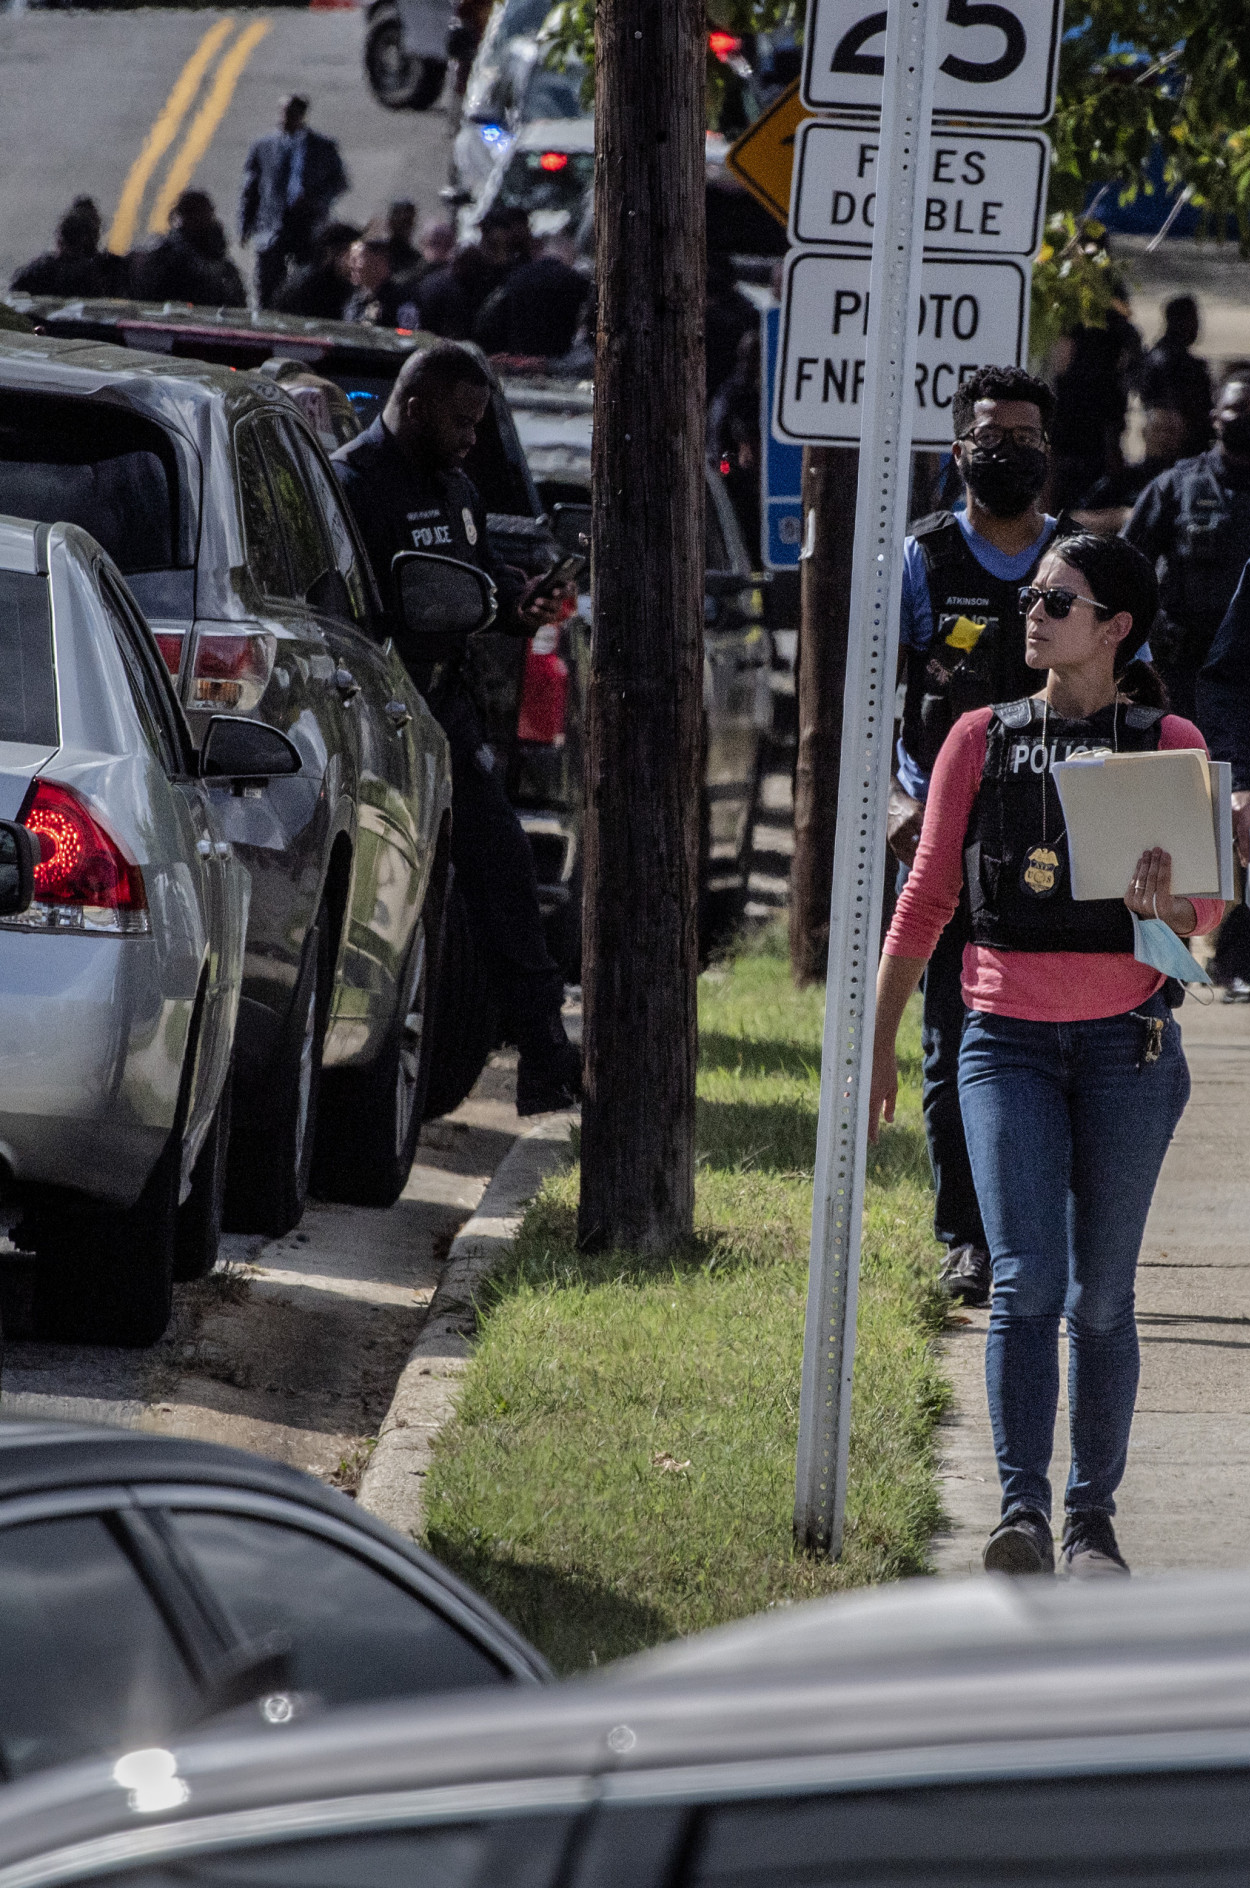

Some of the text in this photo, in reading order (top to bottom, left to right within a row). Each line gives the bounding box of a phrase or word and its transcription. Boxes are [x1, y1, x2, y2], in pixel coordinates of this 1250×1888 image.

[857, 143, 986, 186] FES
[831, 190, 1004, 236] DOBLE
[831, 290, 979, 342] PTO
[946, 596, 990, 606] ATKINSON
